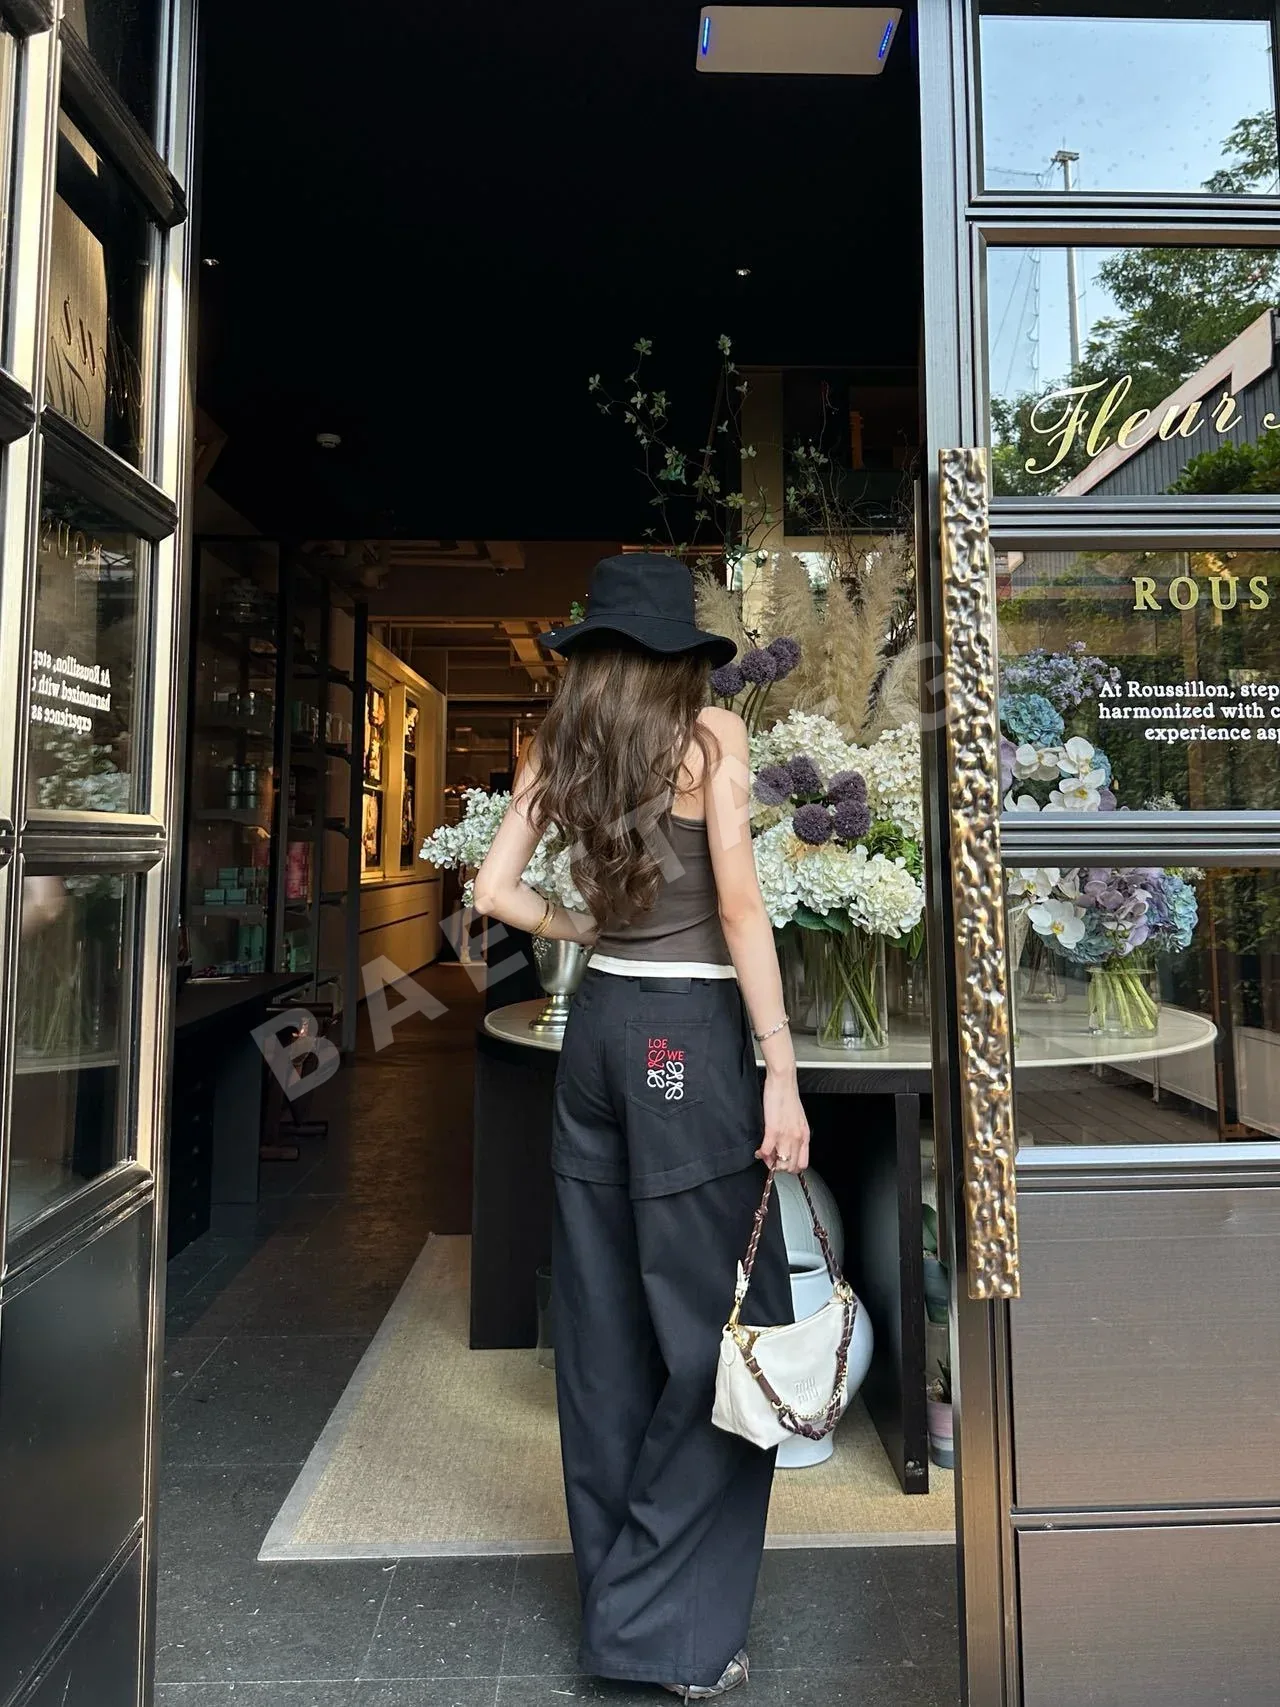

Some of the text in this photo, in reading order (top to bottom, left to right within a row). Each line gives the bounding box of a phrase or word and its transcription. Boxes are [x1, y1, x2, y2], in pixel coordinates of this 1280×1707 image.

[1025, 375, 1242, 475] Fleur
[1133, 576, 1270, 610] ROUS
[1099, 681, 1280, 701] At Roussillon, step
[1098, 702, 1216, 719] harmonized
[1220, 702, 1265, 719] with
[1144, 724, 1252, 744] experience
[648, 1038, 668, 1049] LOE
[667, 1050, 685, 1061] WE
